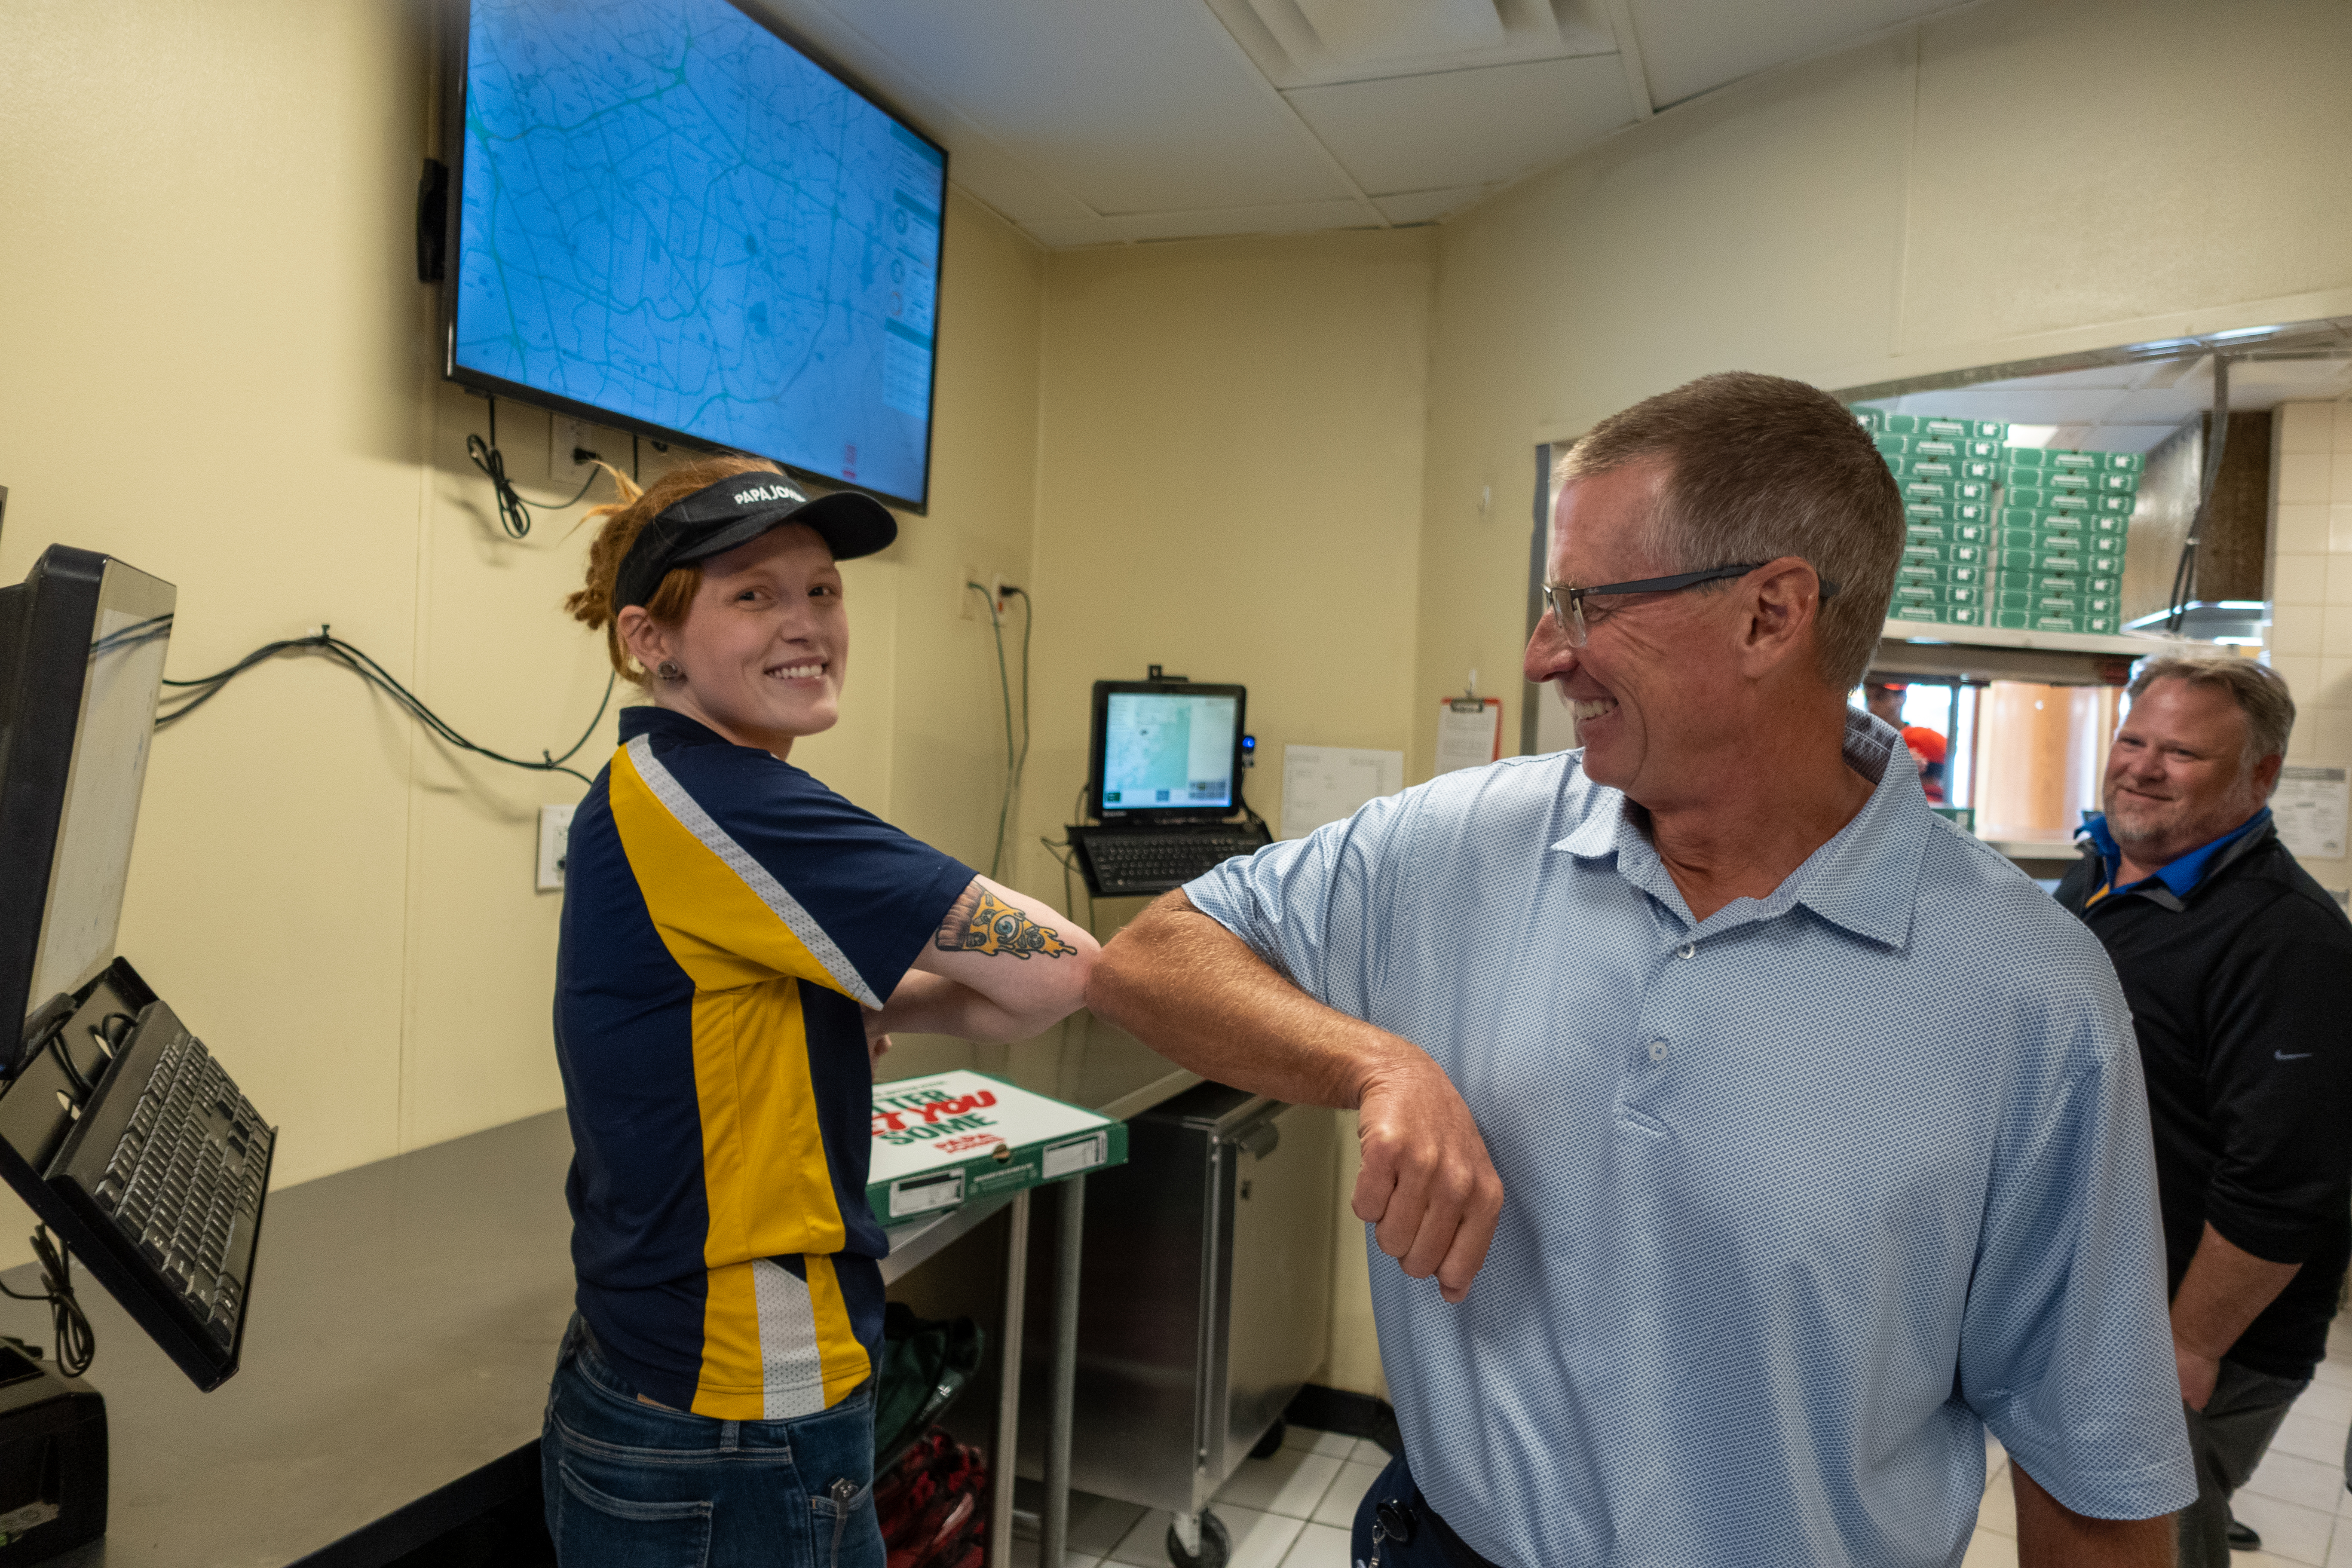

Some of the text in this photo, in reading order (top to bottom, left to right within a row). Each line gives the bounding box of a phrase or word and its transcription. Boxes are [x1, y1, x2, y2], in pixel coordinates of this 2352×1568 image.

[734, 486, 772, 505] PAPA
[906, 1090, 996, 1124] YOU
[879, 1113, 998, 1145] SOME
